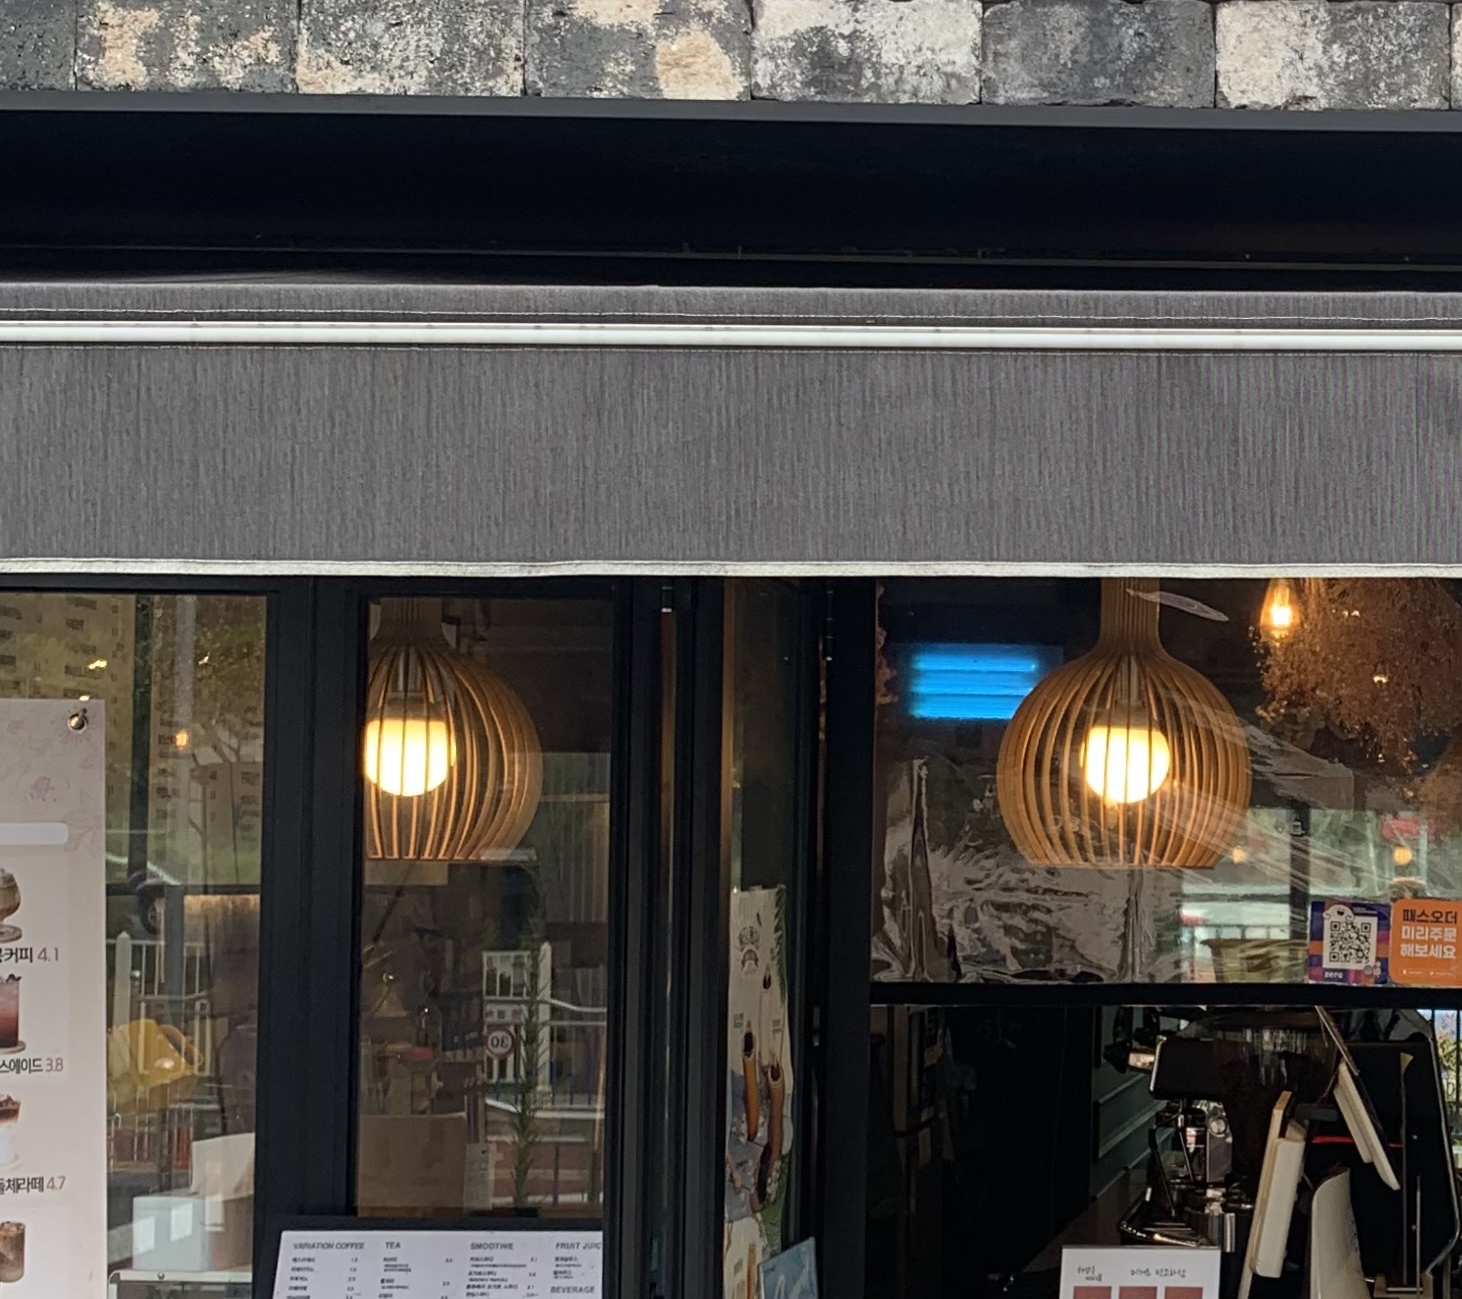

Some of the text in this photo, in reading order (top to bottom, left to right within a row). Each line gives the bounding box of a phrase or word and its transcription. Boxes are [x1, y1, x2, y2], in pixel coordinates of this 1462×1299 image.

[1402, 909, 1458, 925] 패스오더
[1401, 925, 1458, 943] 미리주문
[37, 947, 60, 962] 4.1
[1400, 943, 1457, 960] 해보세요
[45, 1057, 64, 1073] 3.8
[46, 1176, 67, 1191] 4.7
[293, 1242, 365, 1250] VARIATION COFFEE
[385, 1241, 401, 1249] TEA
[470, 1242, 514, 1250] SMOOTHIE
[555, 1242, 580, 1250] FRUIT
[550, 1285, 595, 1294] BEVERAGE
